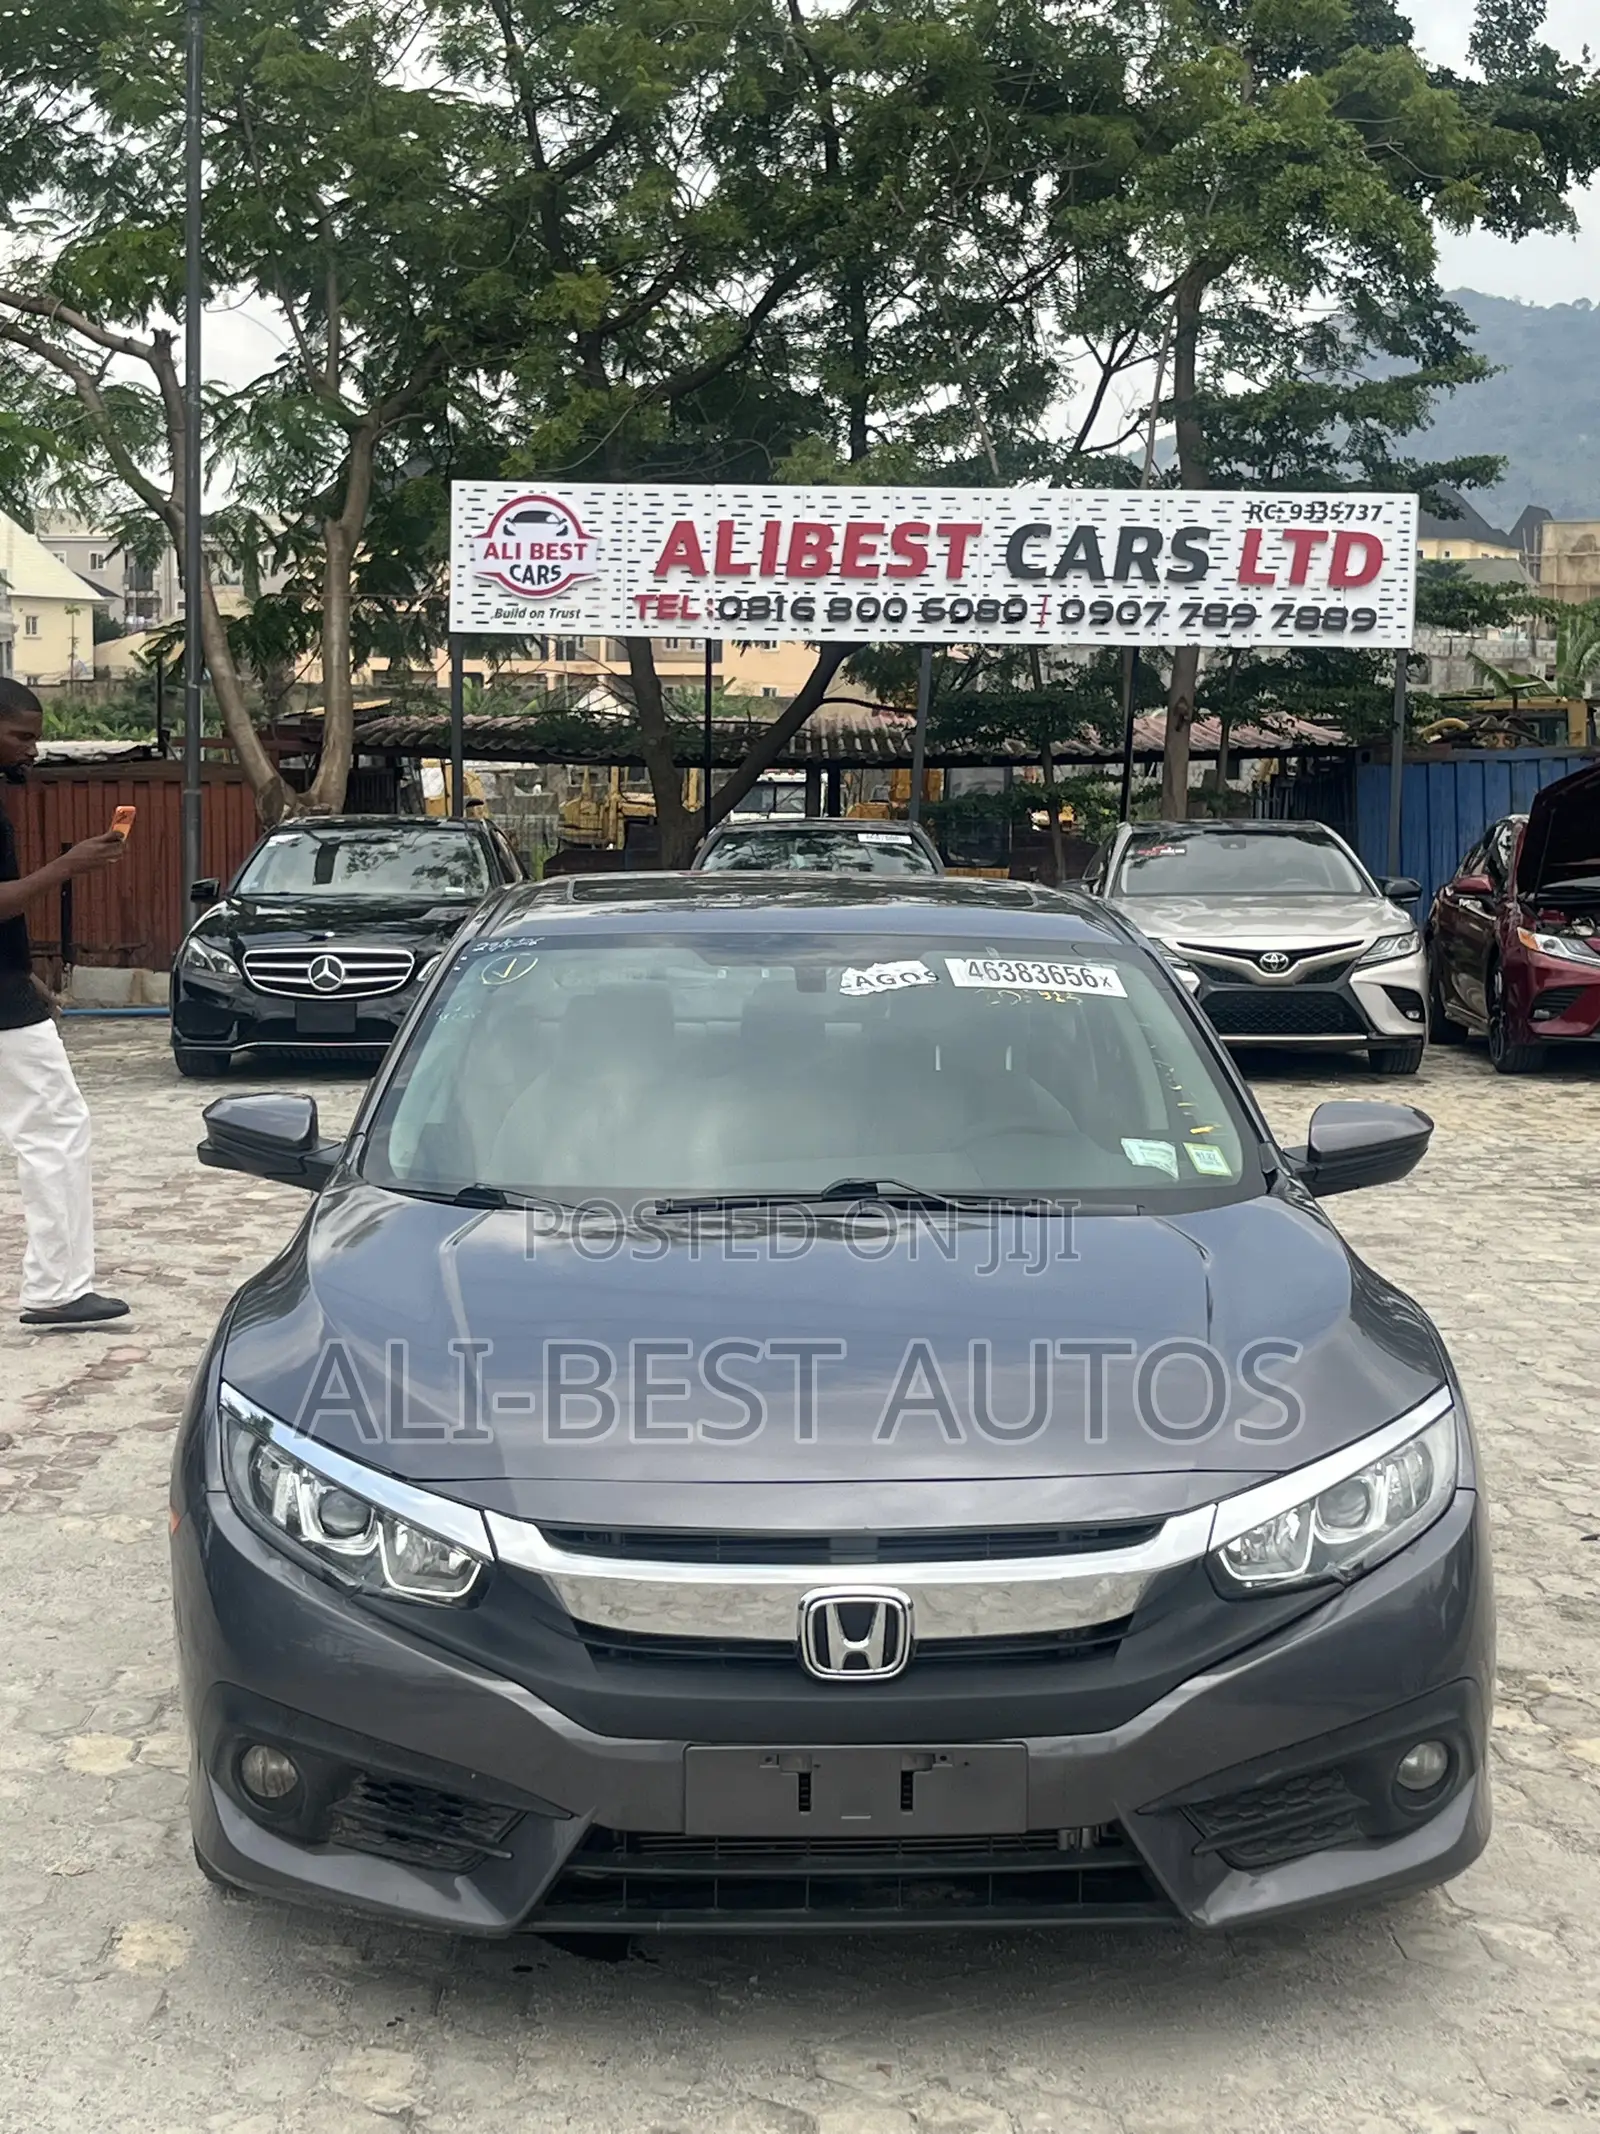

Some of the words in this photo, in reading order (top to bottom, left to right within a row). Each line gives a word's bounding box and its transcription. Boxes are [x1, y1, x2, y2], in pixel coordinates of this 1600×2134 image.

[483, 541, 522, 560] ALI
[530, 542, 588, 561] BEST
[653, 519, 982, 579] ALIBEST
[1005, 522, 1212, 584] CARS
[1237, 527, 1385, 588] LTD
[509, 564, 562, 586] CARS
[494, 607, 527, 619] Build
[529, 611, 545, 619] on
[550, 608, 581, 619] Trust
[717, 595, 816, 622] 0816
[828, 597, 908, 623] 800
[920, 597, 1028, 624] 6080
[1060, 600, 1166, 626] 0907
[1179, 602, 1257, 629] 789
[1270, 603, 1378, 633] 7889
